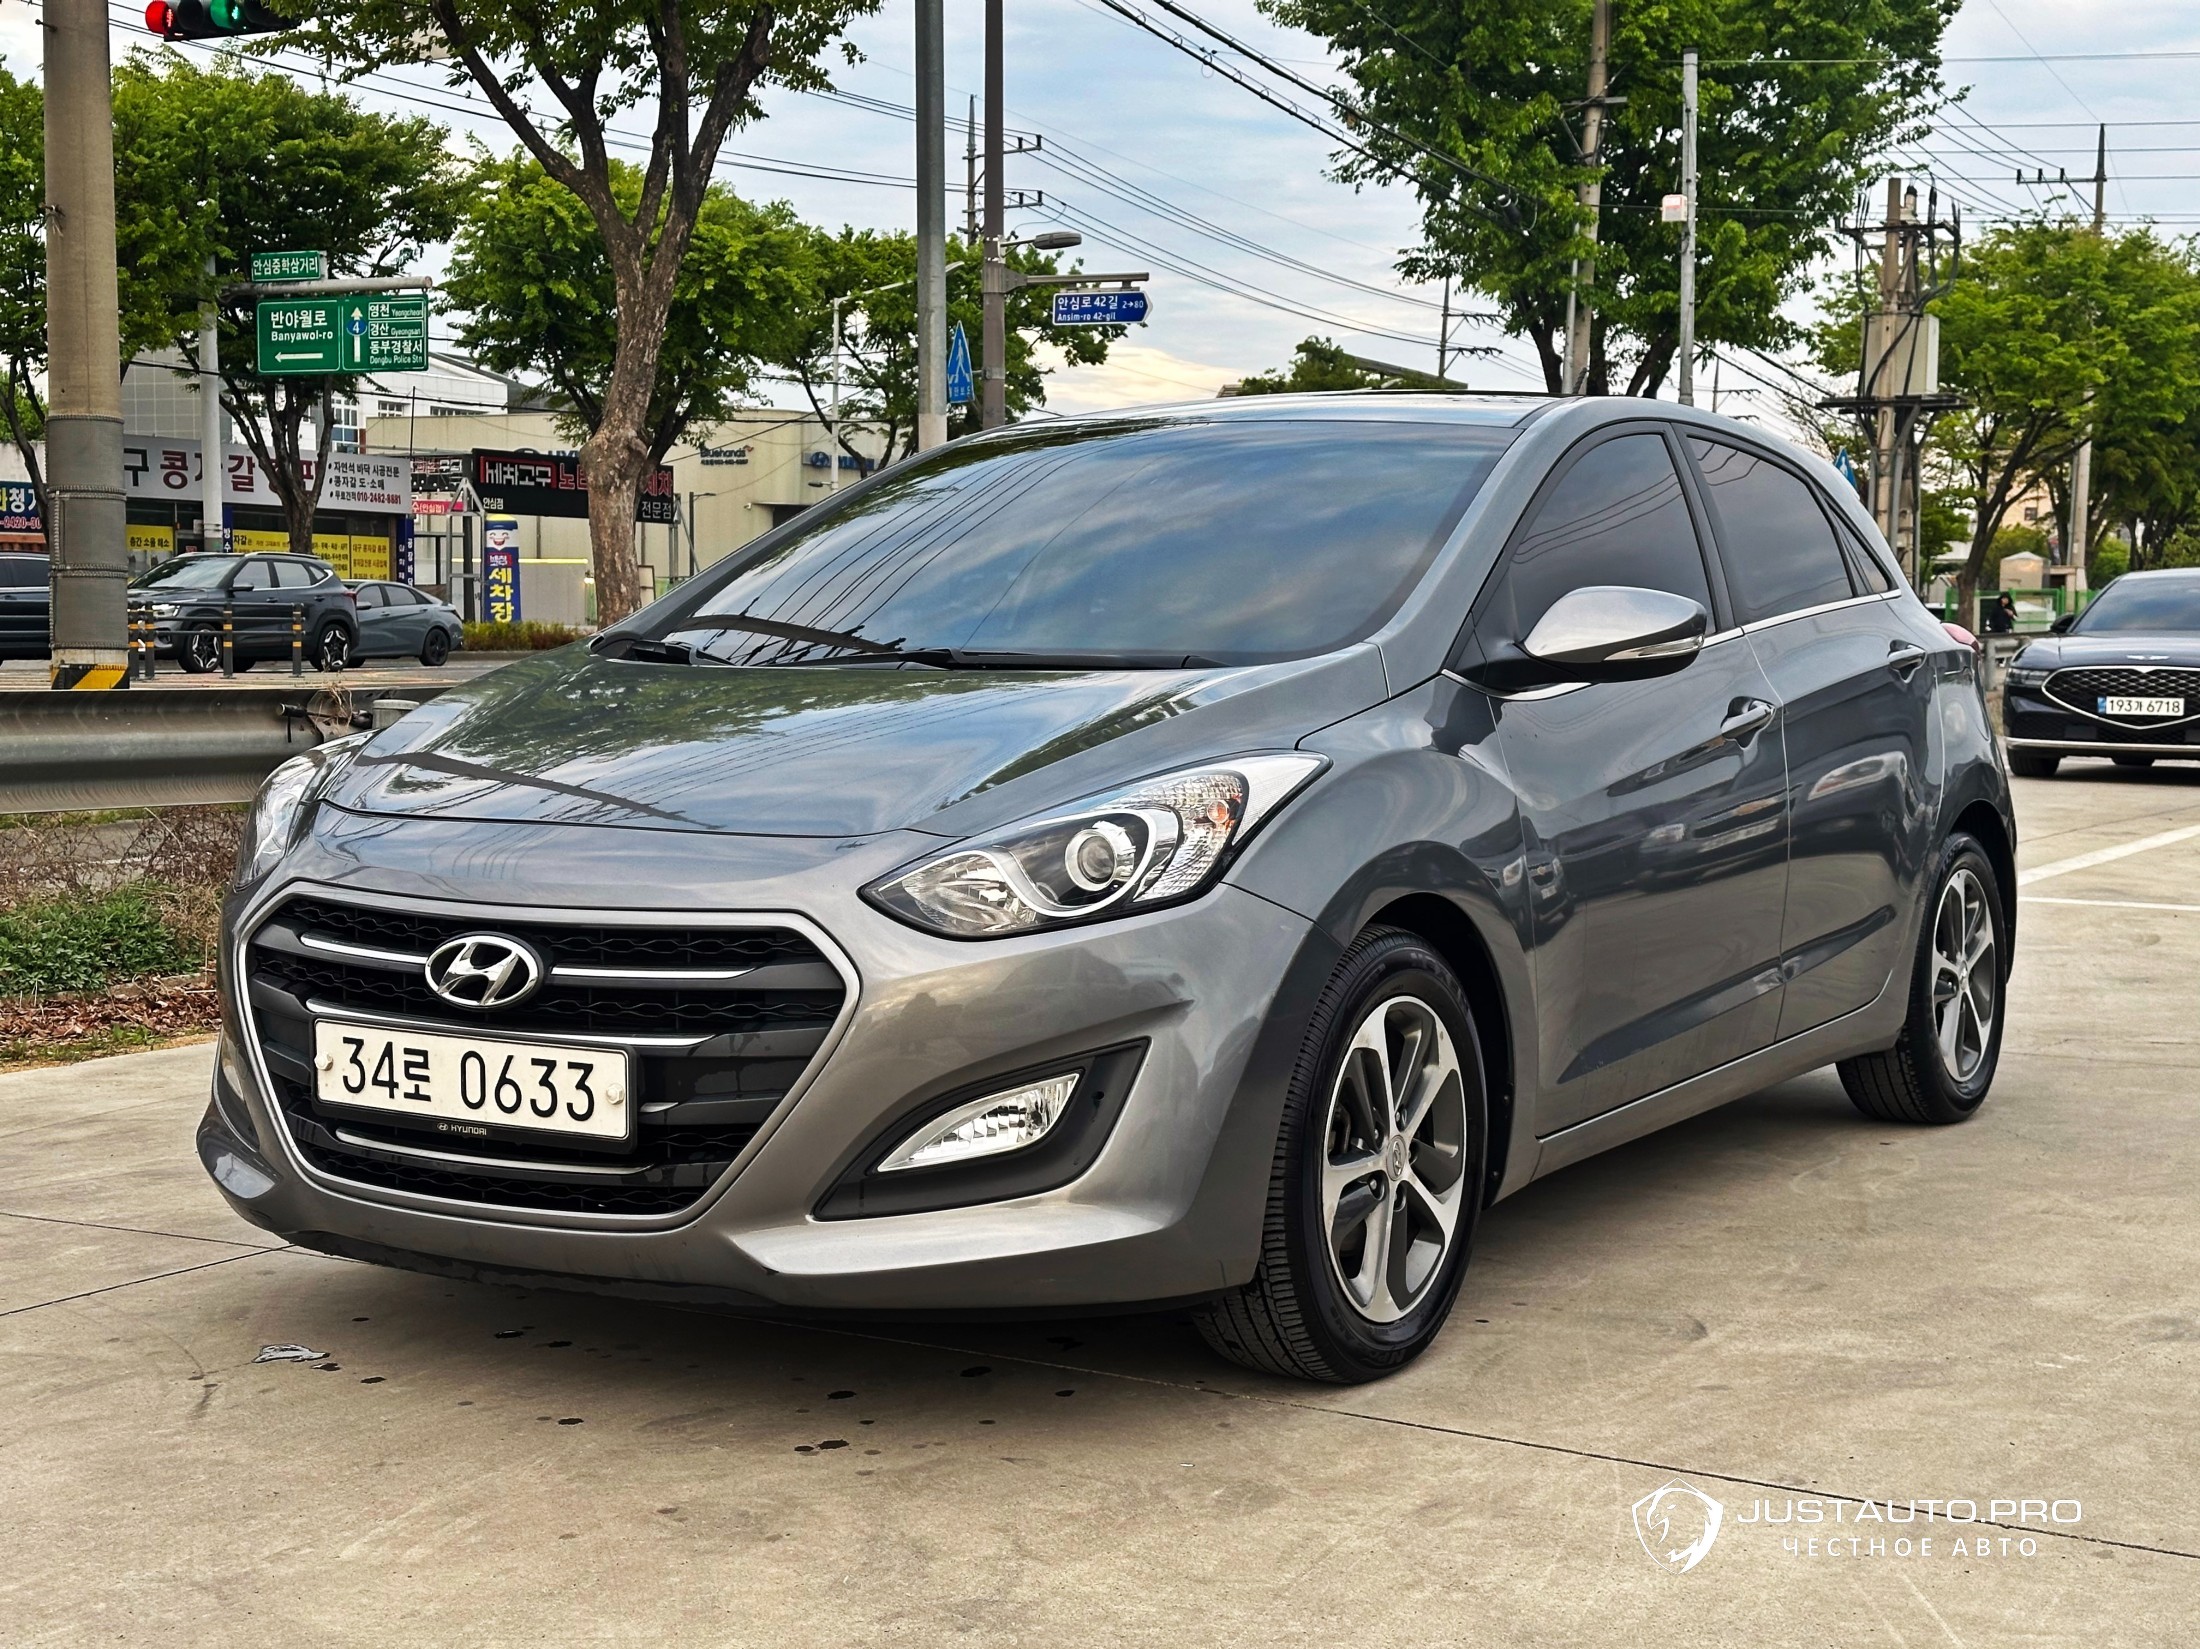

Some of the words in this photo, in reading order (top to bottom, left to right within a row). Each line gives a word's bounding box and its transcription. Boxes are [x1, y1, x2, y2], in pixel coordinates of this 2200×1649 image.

[253, 257, 318, 276] 안심중학삼거리
[1057, 296, 1092, 311] 안심로
[1093, 295, 1118, 309] 42길
[369, 304, 390, 317] 영천
[392, 308, 423, 318] Yeongcheon
[1057, 312, 1091, 322] Ansim-ro
[1093, 312, 1116, 322] 42-gil
[271, 310, 328, 329] 반야월로
[353, 322, 360, 333] 4
[370, 323, 389, 336] 경산
[391, 328, 421, 338] Gyeongsan
[271, 330, 333, 344] Banyawol-ro
[369, 340, 423, 354] 동부경찰서
[370, 356, 392, 366] Dongbu
[394, 355, 411, 364] Police
[412, 355, 423, 364] Stn
[334, 461, 355, 474] 자연석
[357, 464, 370, 476] 바닥
[372, 465, 400, 478] 시공전문
[334, 476, 357, 488] 콩자갈
[642, 501, 672, 519] 전문점
[488, 567, 514, 623] 세차장
[2147, 700, 2180, 714] 6718
[342, 1036, 432, 1102] 34로
[460, 1050, 595, 1122] 0633
[451, 1124, 487, 1136] HYUNDAI
